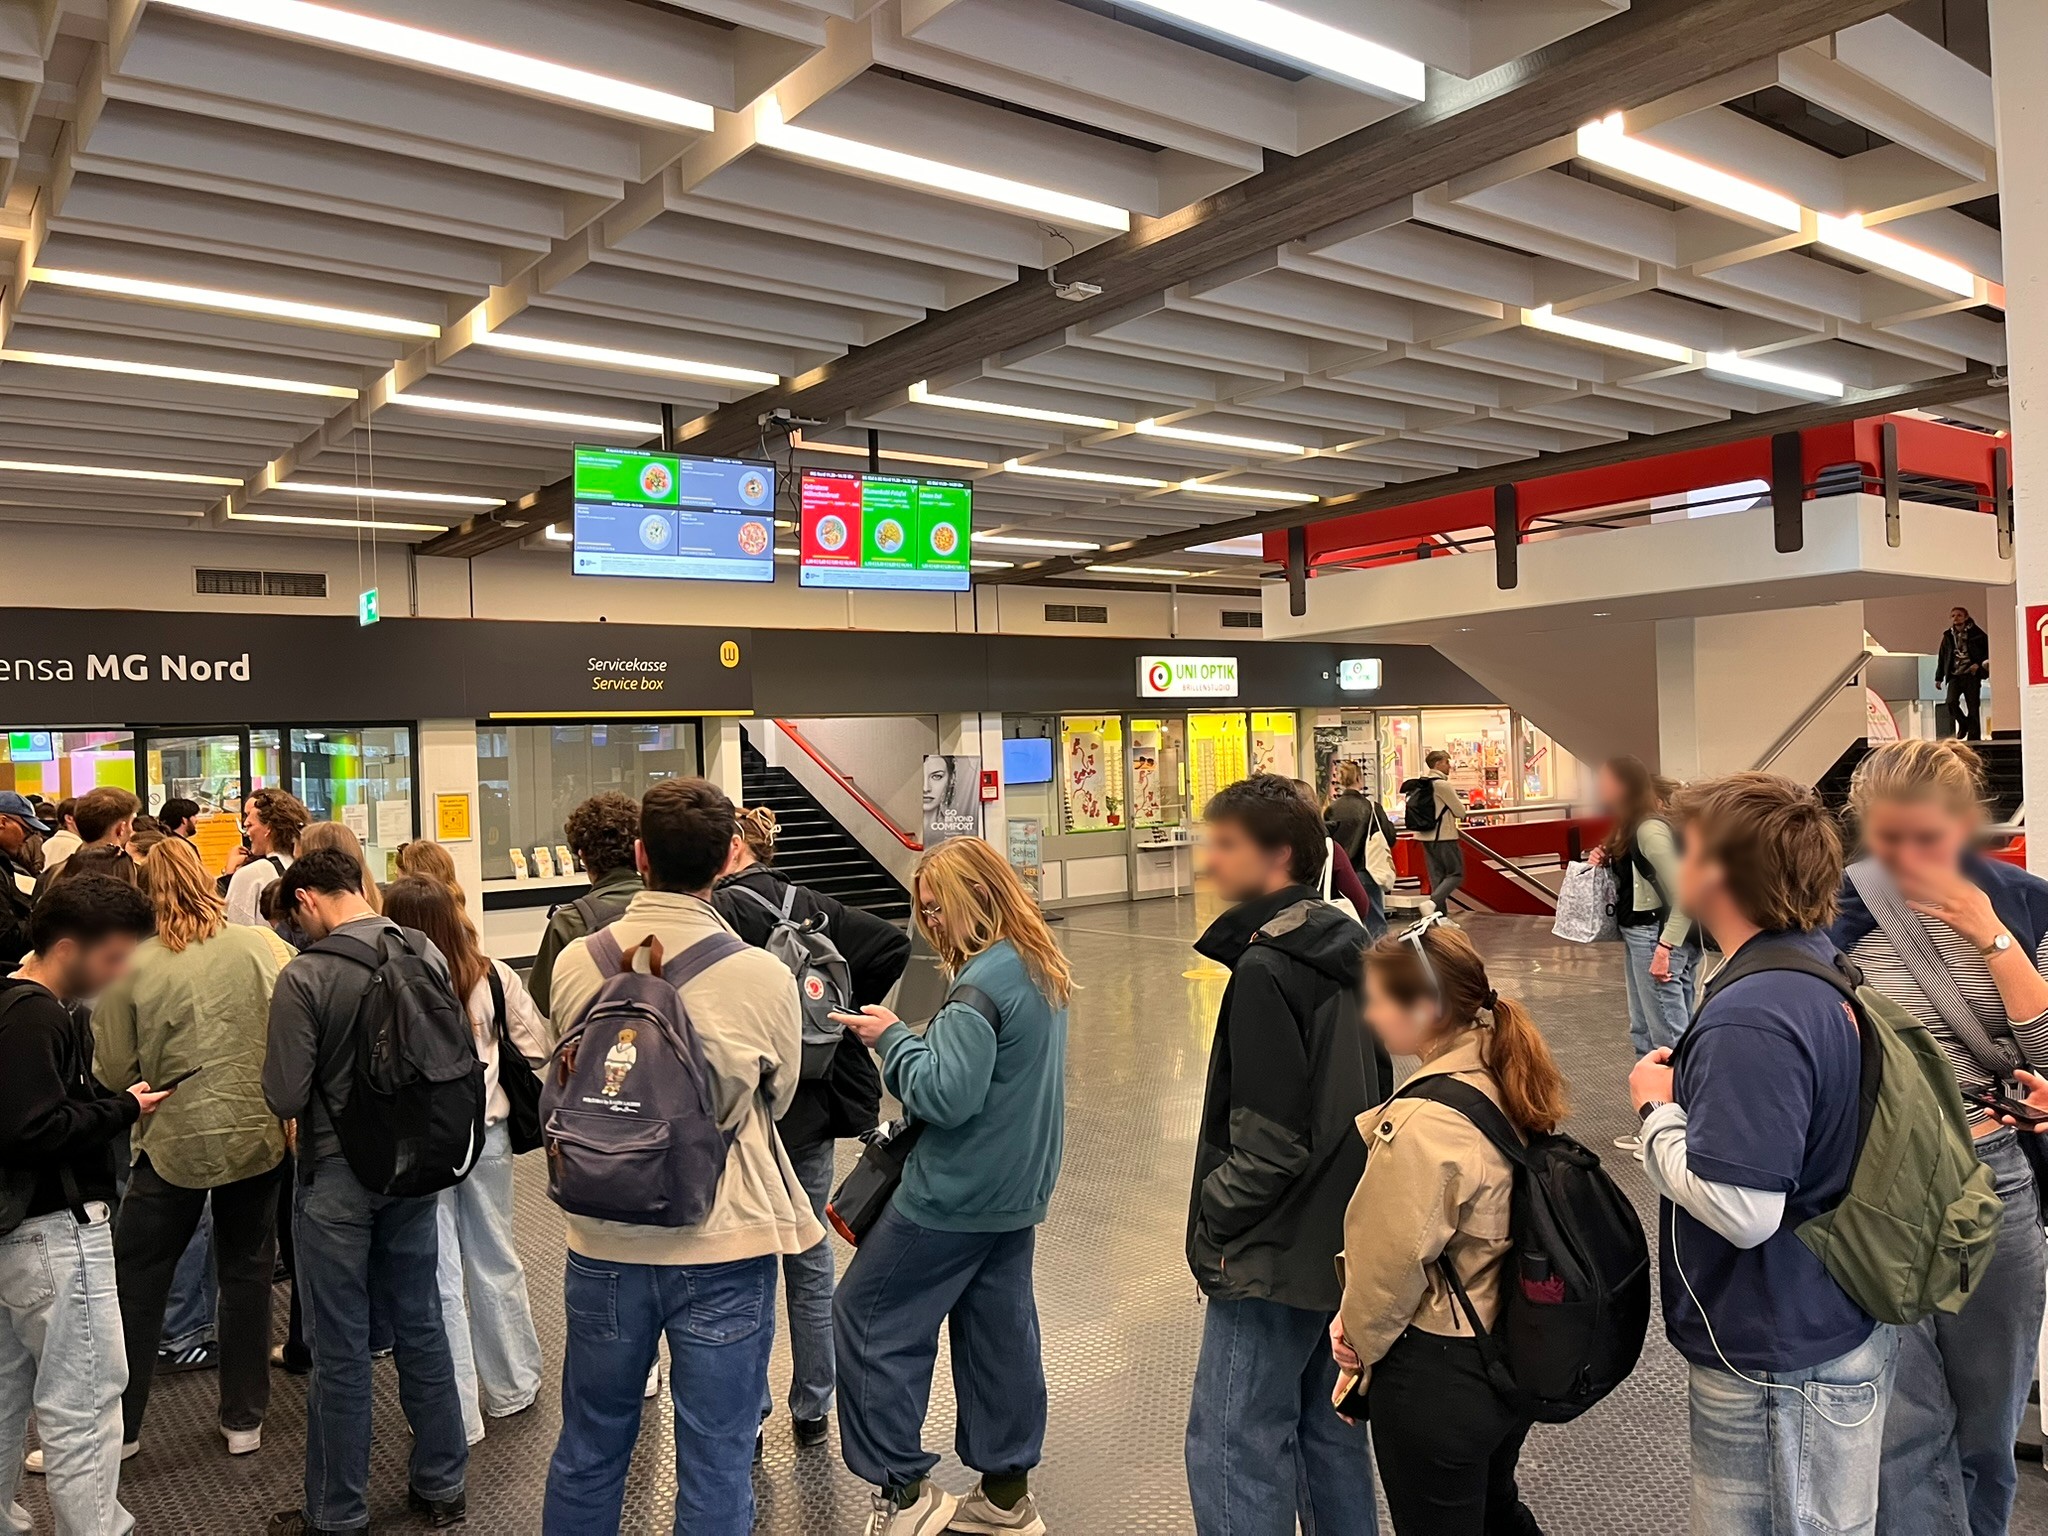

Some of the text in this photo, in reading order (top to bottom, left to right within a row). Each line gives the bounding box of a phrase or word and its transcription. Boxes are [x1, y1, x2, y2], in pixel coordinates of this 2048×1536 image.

[86, 654, 149, 681] MG
[161, 653, 250, 682] Nord
[587, 657, 668, 672] Servicekasse
[1176, 664, 1235, 679] UNI OPTIK
[592, 676, 664, 690] Service box
[1182, 684, 1231, 692] BRILLENSTUDIO
[944, 815, 974, 823] BEYOND
[930, 822, 974, 831] COMFORT
